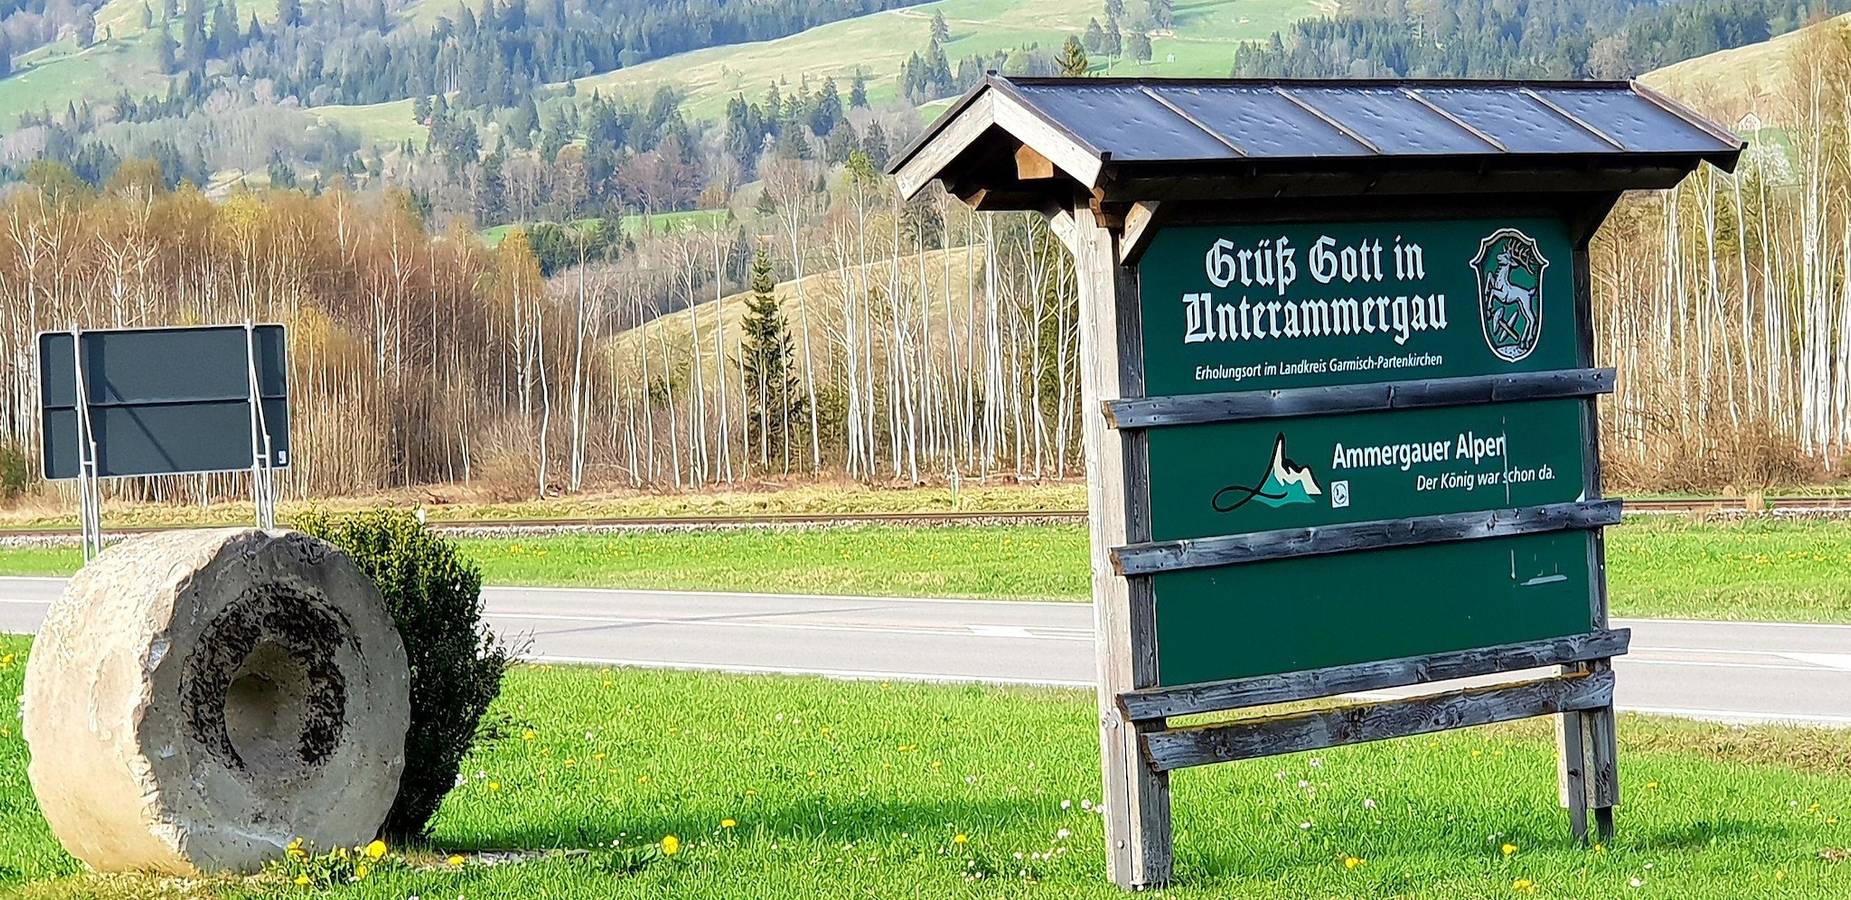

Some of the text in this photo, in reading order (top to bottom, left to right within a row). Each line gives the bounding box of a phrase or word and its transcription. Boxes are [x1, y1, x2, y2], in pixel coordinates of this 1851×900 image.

[1205, 234, 1426, 296] Grüß Gott in
[1182, 291, 1448, 345] Unterammergau
[1195, 353, 1443, 381] Erholungsort im Landkreis Garmisch-Partenkirchen
[1332, 431, 1505, 472] Ammergauer Alpen
[1416, 464, 1555, 492] Der König war schon da.
